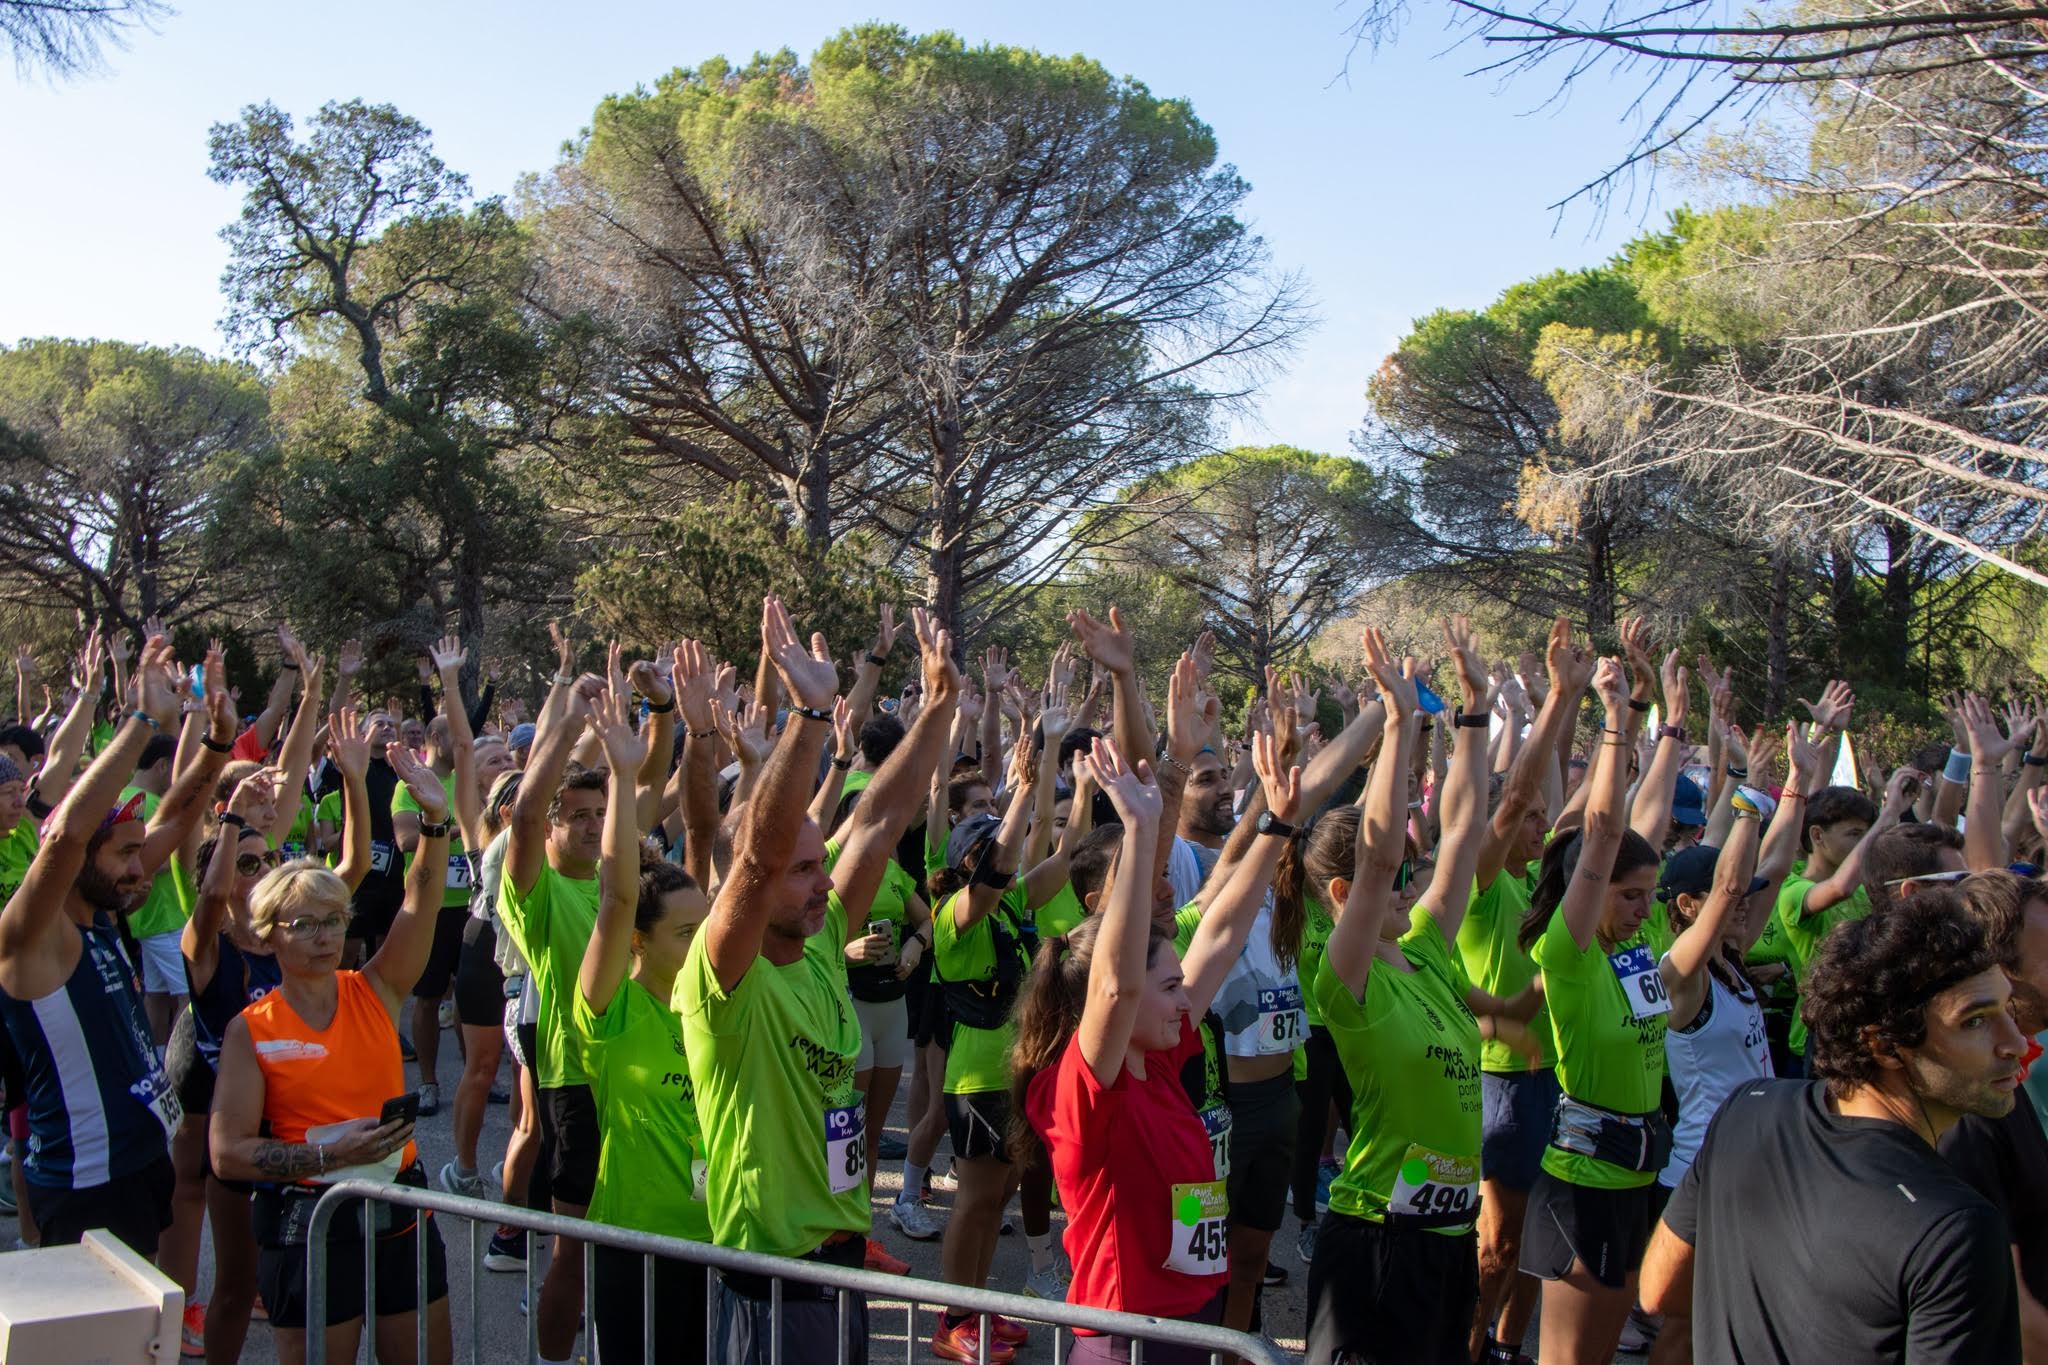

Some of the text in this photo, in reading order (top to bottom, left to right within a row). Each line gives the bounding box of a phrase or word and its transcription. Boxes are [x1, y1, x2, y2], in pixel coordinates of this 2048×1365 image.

[1613, 954, 1632, 969] 10
[1261, 991, 1275, 1004] 10
[829, 1110, 850, 1129] 10
[1408, 1183, 1469, 1215] 499
